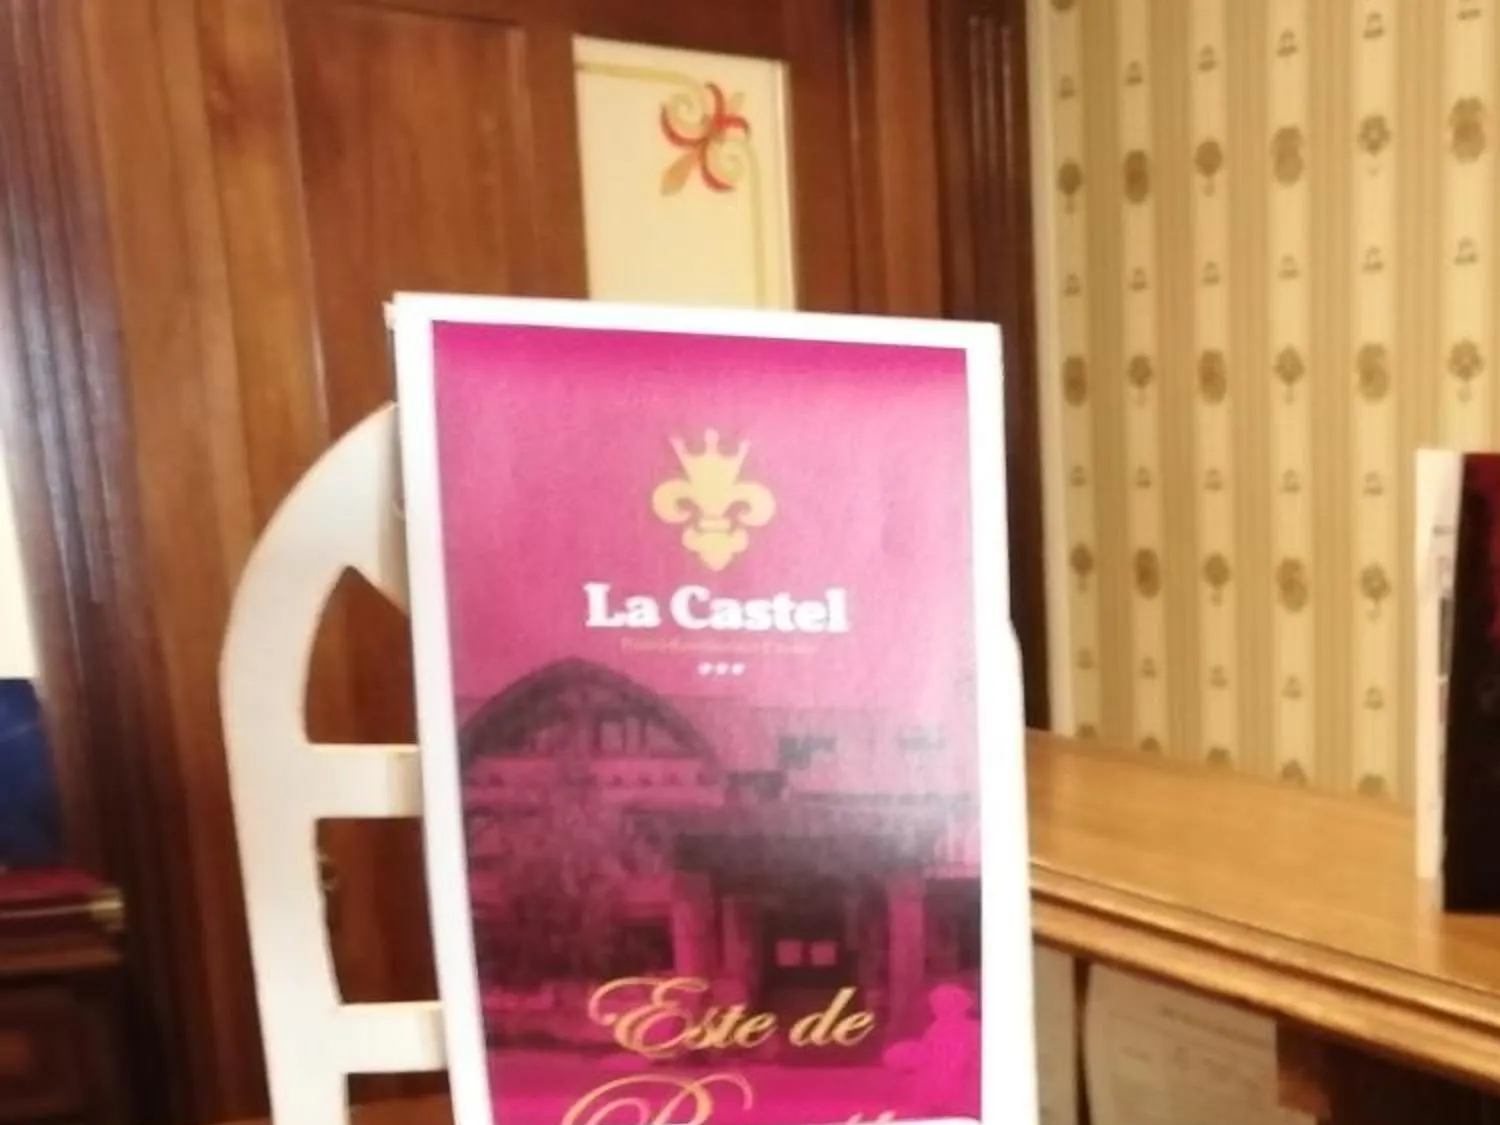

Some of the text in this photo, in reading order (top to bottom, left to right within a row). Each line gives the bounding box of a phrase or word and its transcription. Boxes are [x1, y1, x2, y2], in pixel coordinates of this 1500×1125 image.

[584, 582, 850, 633] La Castel
[588, 977, 876, 1060] Este de
